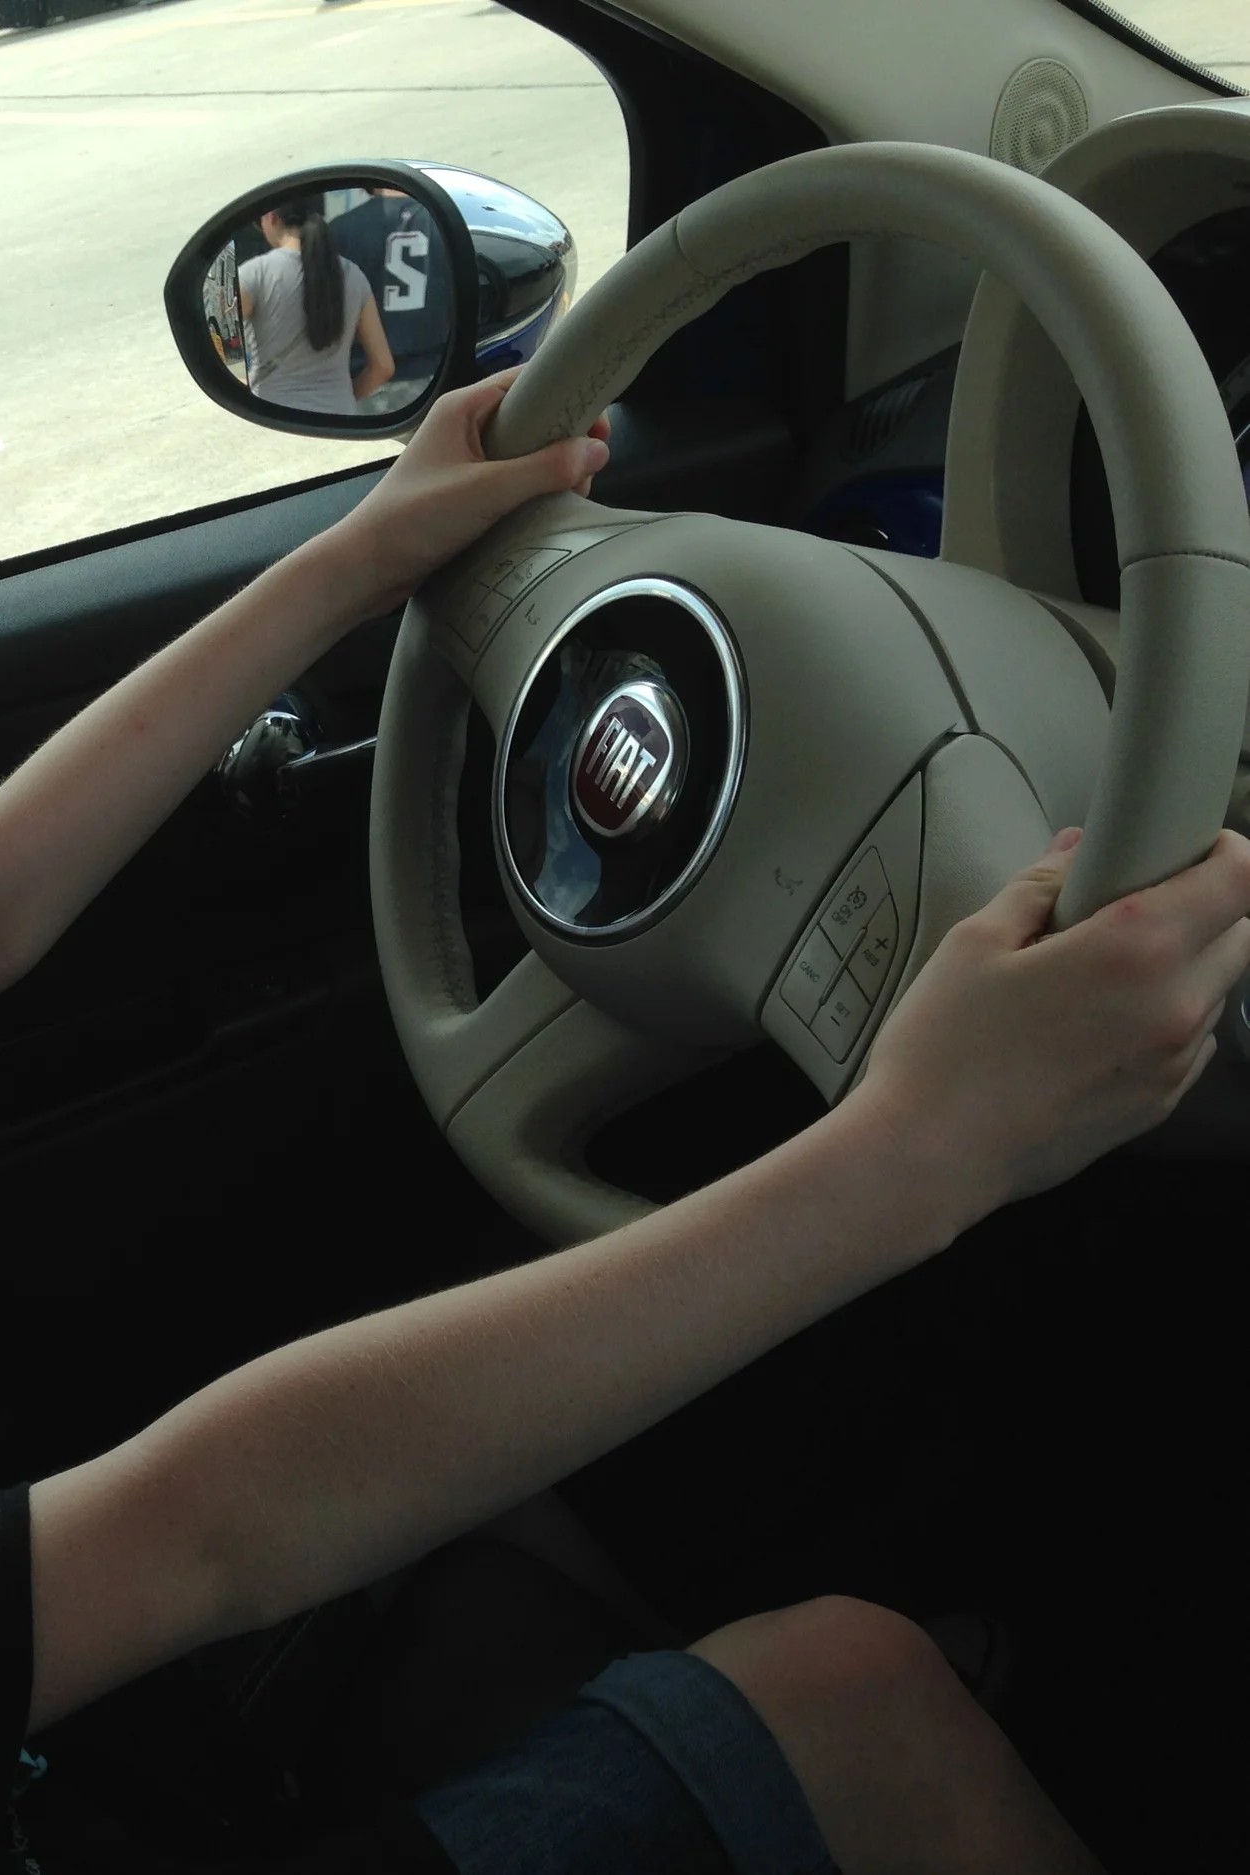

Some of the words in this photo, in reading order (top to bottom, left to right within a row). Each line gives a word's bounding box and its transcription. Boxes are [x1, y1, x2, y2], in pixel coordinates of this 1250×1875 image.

[586, 716, 657, 810] FIAT
[831, 911, 848, 926] OFF
[799, 961, 820, 983] CANC
[834, 1001, 851, 1018] SET
